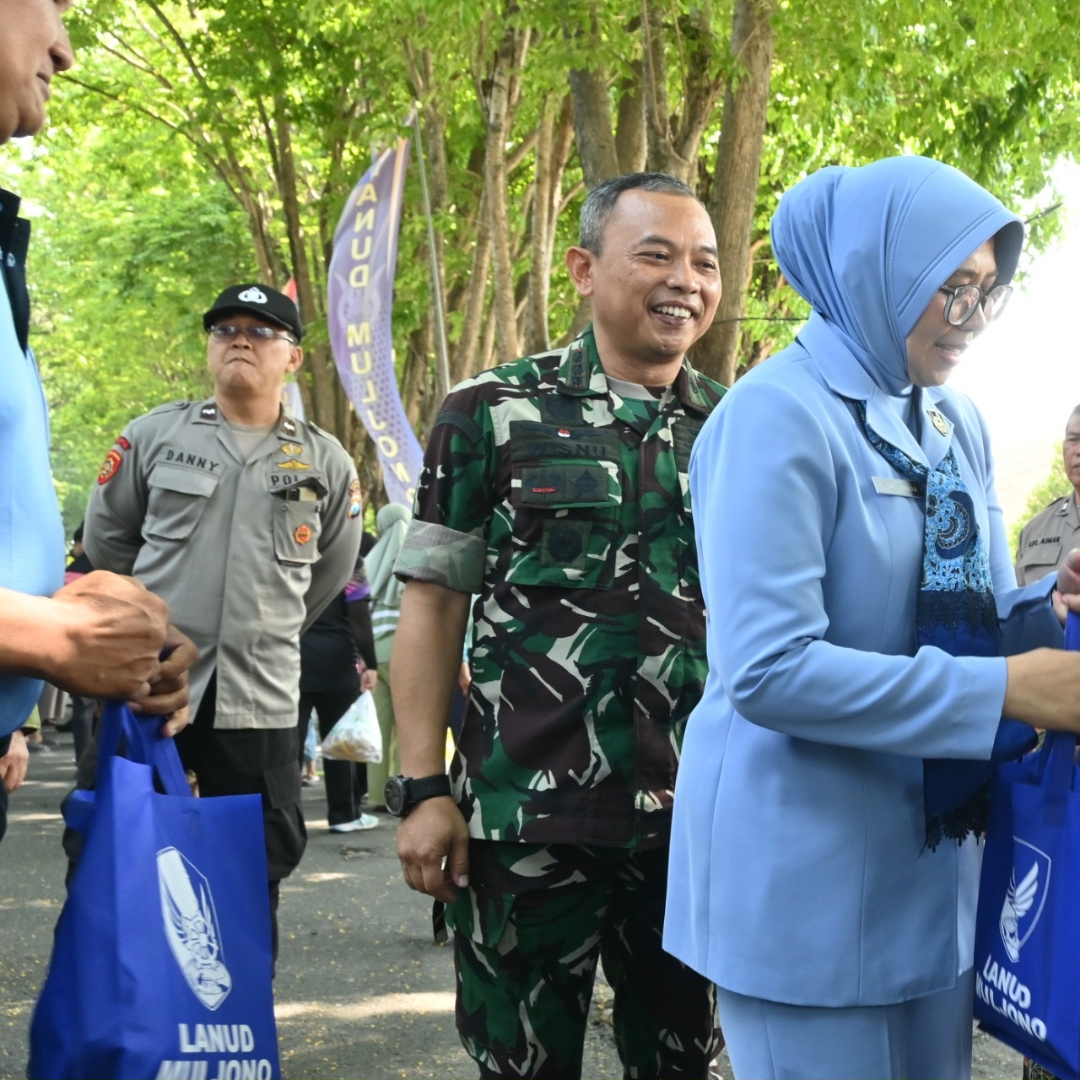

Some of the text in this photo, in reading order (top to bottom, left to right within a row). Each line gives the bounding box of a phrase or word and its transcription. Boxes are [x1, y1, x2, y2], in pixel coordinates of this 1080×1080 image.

[166, 450, 220, 472] DANNY
[1028, 535, 1061, 549] SULAIMAN
[983, 953, 1031, 1009] LANUD
[975, 970, 1047, 1042] MULJONO
[178, 1023, 255, 1053] LANUD
